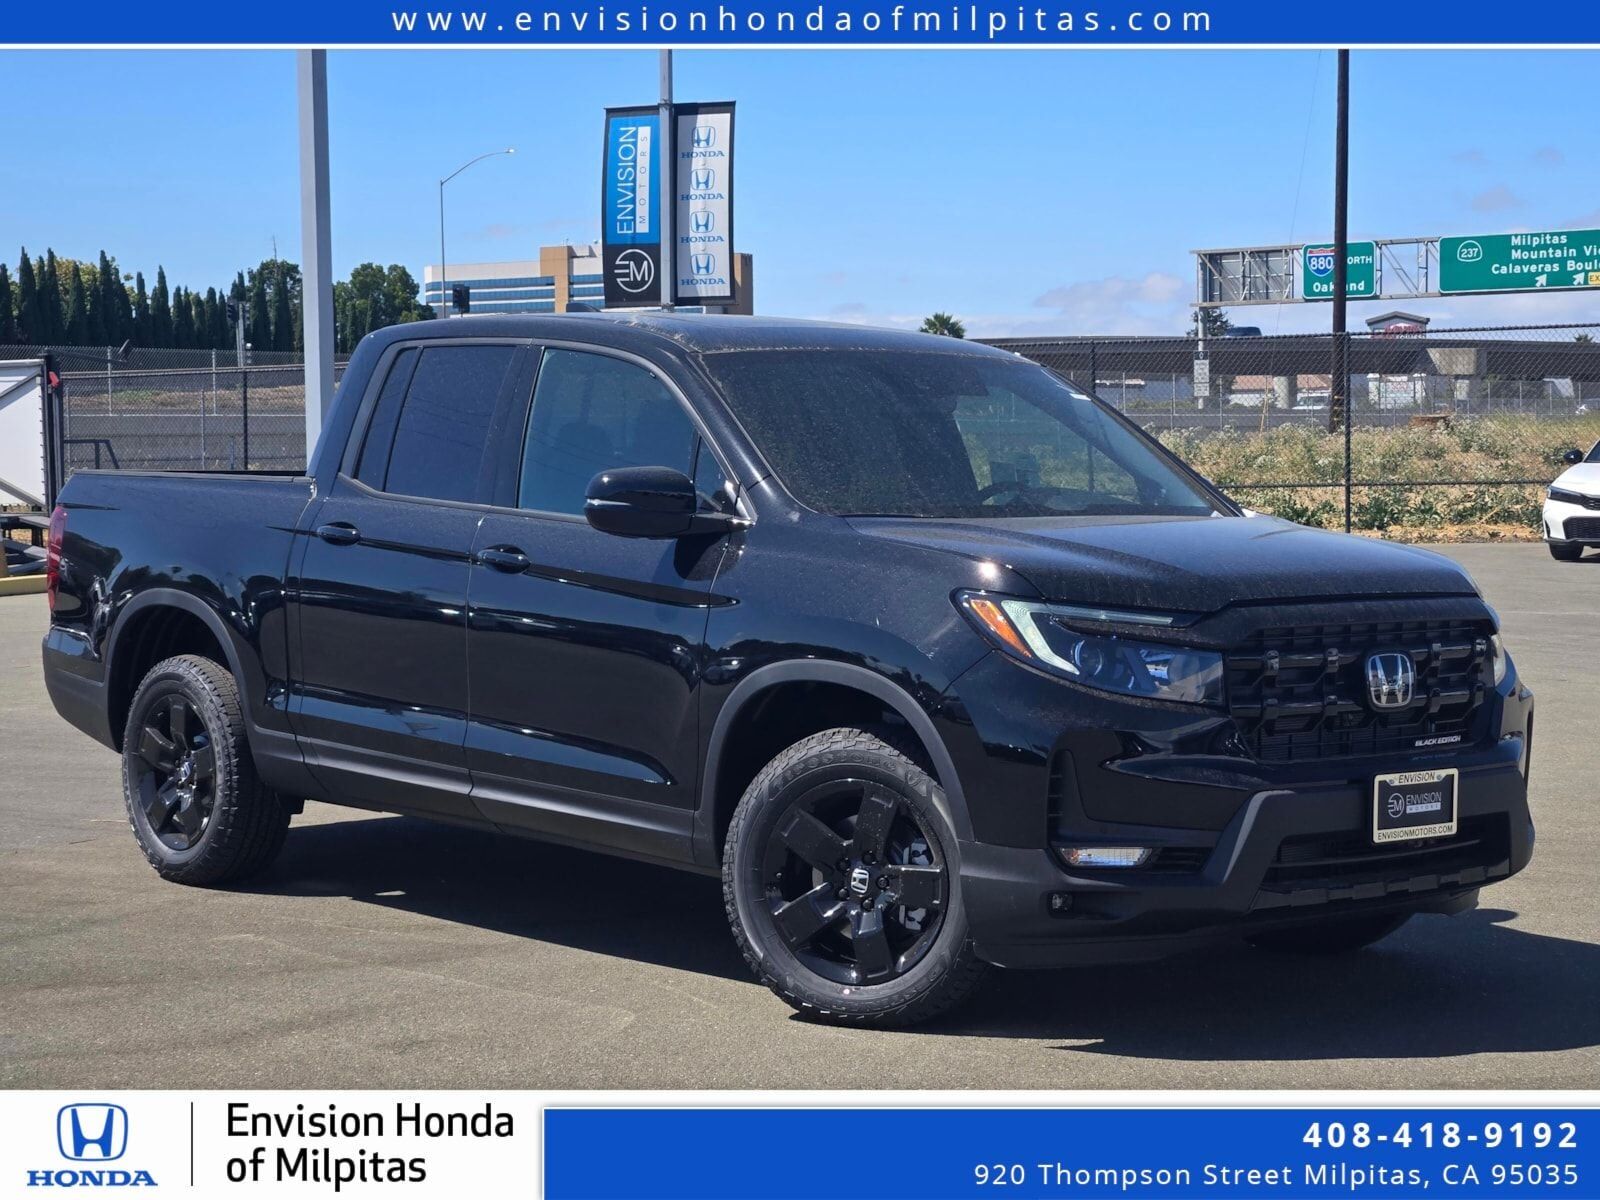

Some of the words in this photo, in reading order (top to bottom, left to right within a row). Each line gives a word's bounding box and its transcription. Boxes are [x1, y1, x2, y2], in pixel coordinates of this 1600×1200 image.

[681, 150, 725, 158] HONDA
[616, 126, 637, 234] ENVISION
[639, 136, 648, 223] MOTORS
[681, 193, 724, 201] HONDA
[680, 235, 724, 243] HONDA
[1511, 234, 1568, 247] Milpitas
[1461, 247, 1479, 258] 237
[1511, 247, 1577, 260] Mountain
[1310, 256, 1334, 270] 880
[1346, 255, 1373, 265] ORTH
[1491, 263, 1560, 275] Calaveras
[1566, 259, 1600, 271] Boul
[681, 277, 726, 286] HONDA
[1398, 772, 1435, 784] ENVISION
[1406, 792, 1442, 805] ENVISION
[1377, 824, 1453, 841] ENVISIONMOTORS.COM
